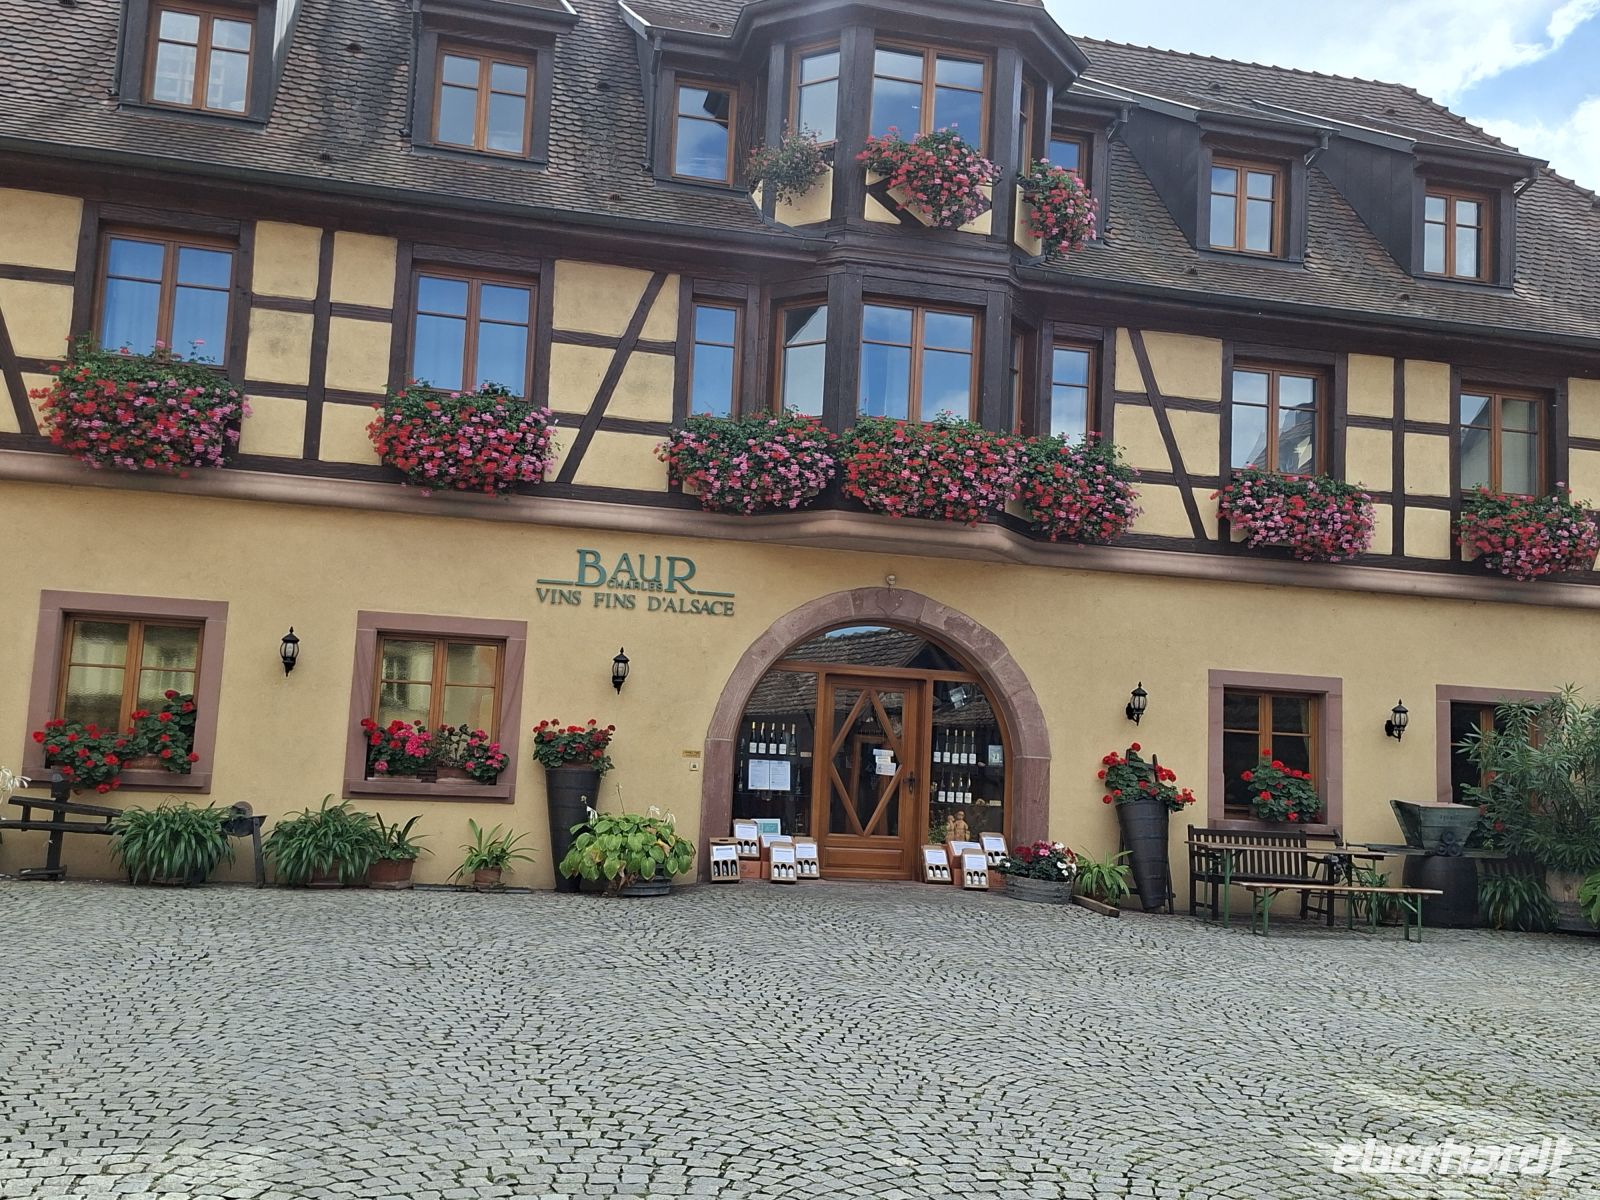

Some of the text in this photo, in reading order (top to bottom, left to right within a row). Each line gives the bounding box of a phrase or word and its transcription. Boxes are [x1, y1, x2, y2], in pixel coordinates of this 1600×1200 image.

[575, 548, 697, 594] BAUR
[607, 579, 663, 592] CHARLES
[536, 587, 735, 617] VINS FINS D'ALSACE
